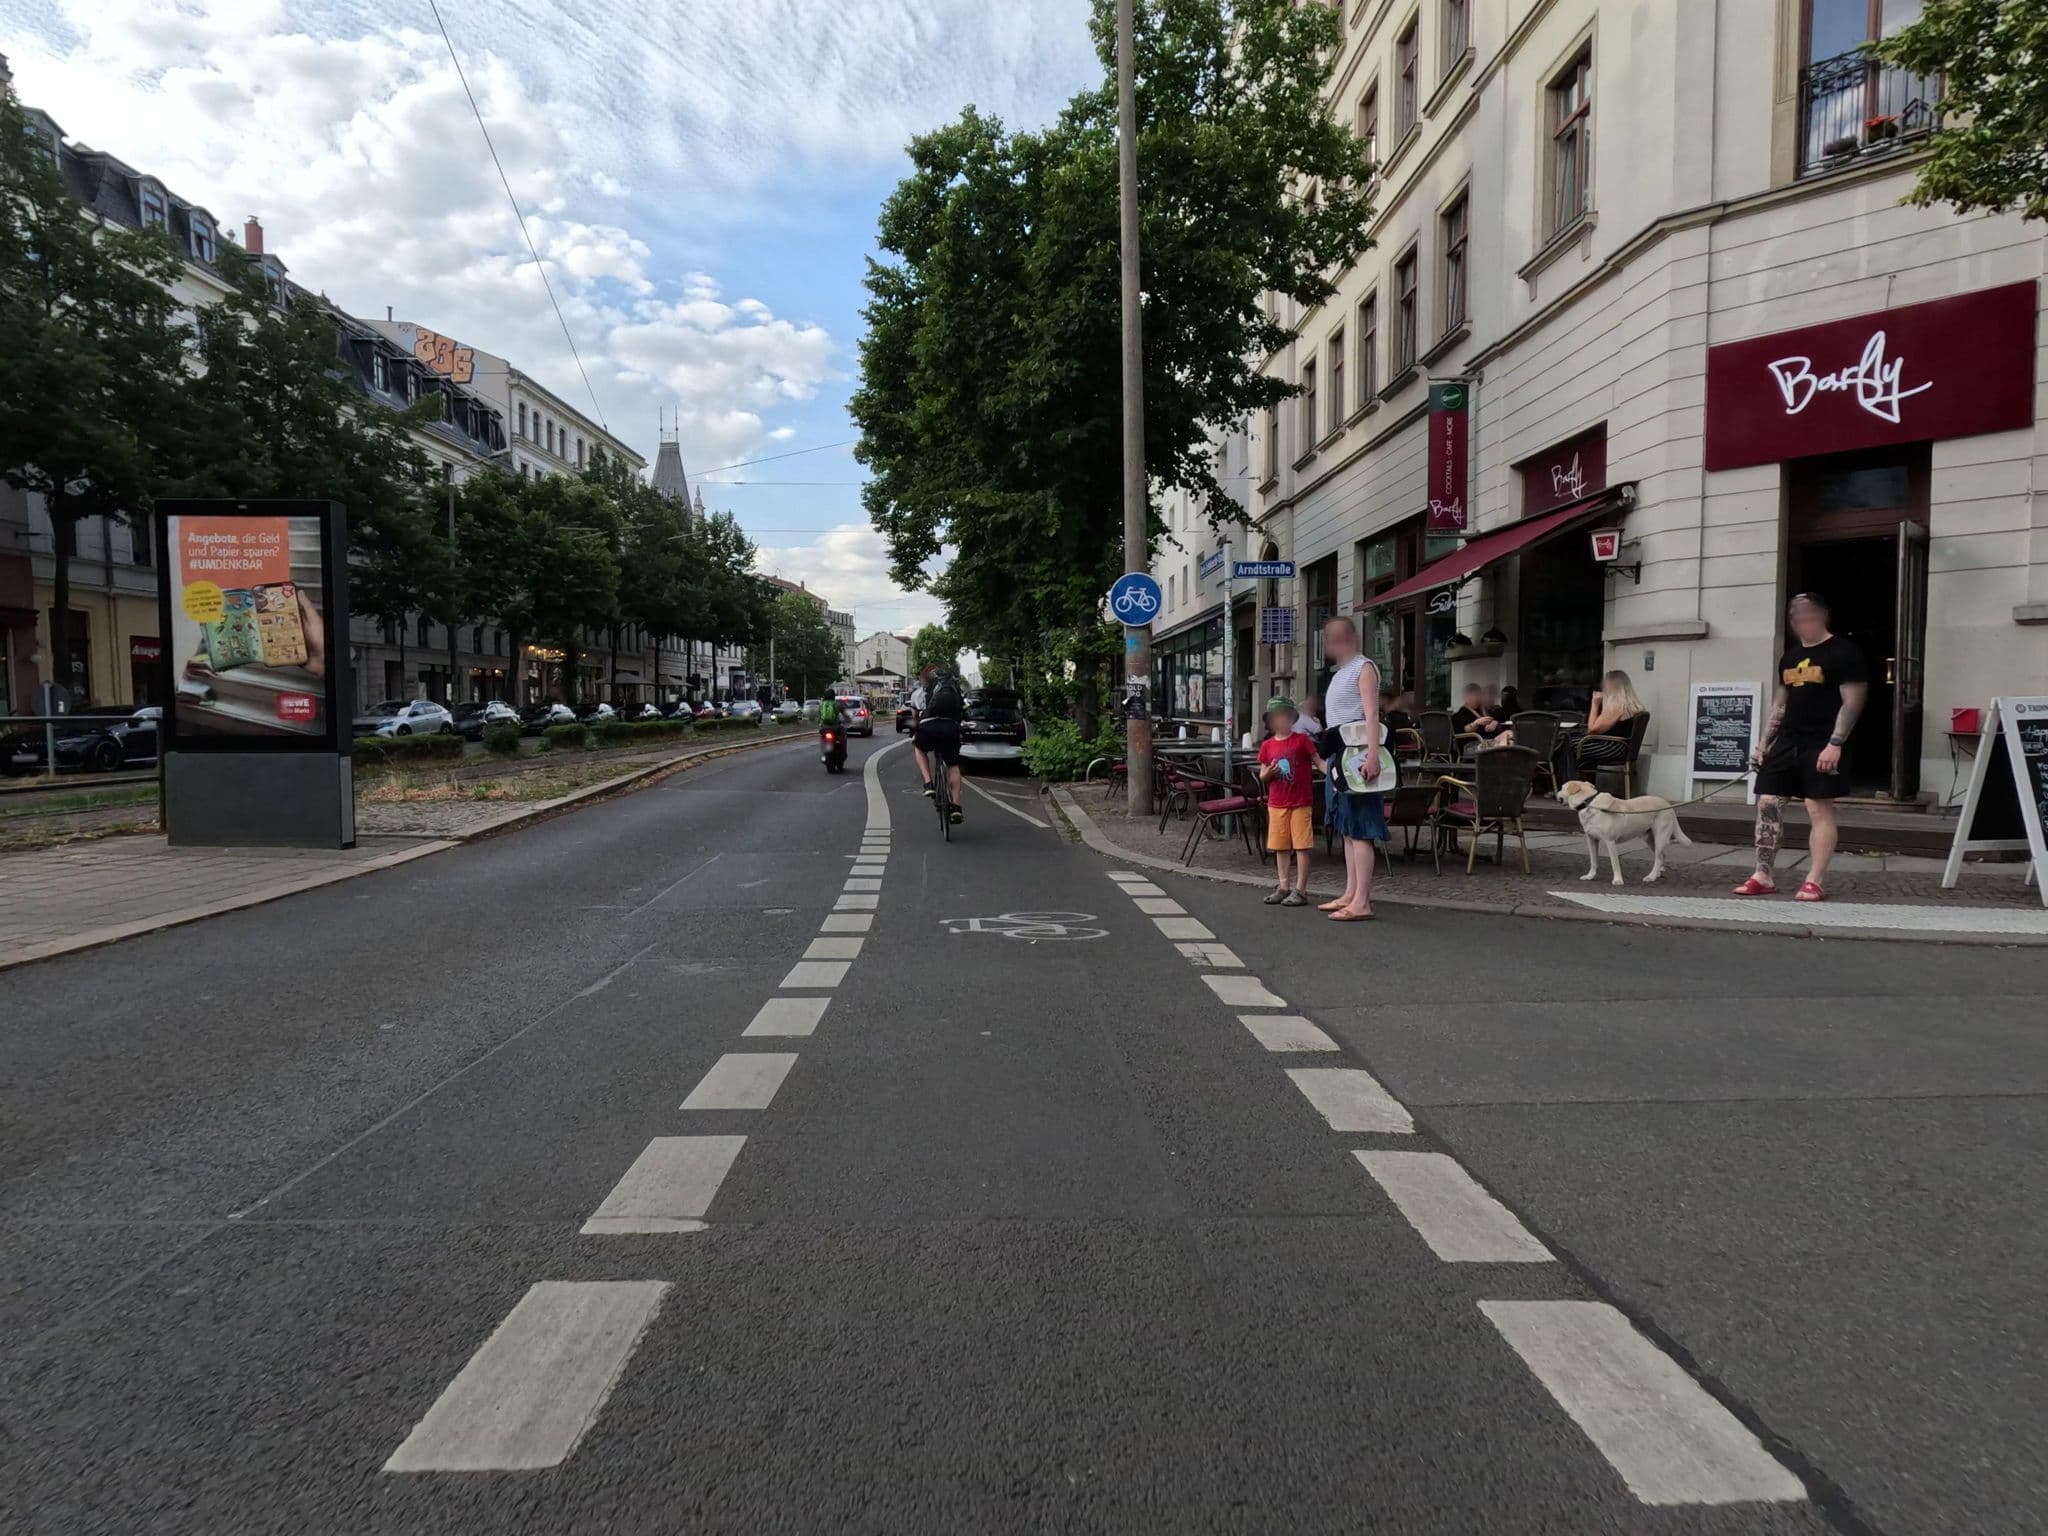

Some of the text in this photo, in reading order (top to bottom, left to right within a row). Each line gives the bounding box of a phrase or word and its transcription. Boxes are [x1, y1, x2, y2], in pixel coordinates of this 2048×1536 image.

[1767, 330, 1933, 424] Barfly
[1446, 416, 1454, 435] MORE
[1445, 459, 1453, 495] COCKTAILS
[1551, 451, 1588, 499] Barfly
[1429, 496, 1464, 525] Barfly
[242, 533, 257, 544] die
[258, 532, 280, 544] Geld
[188, 546, 280, 558] und Papier sparen?
[189, 559, 264, 570] #UMDENKBAR
[1237, 563, 1292, 576] Arndtstraße
